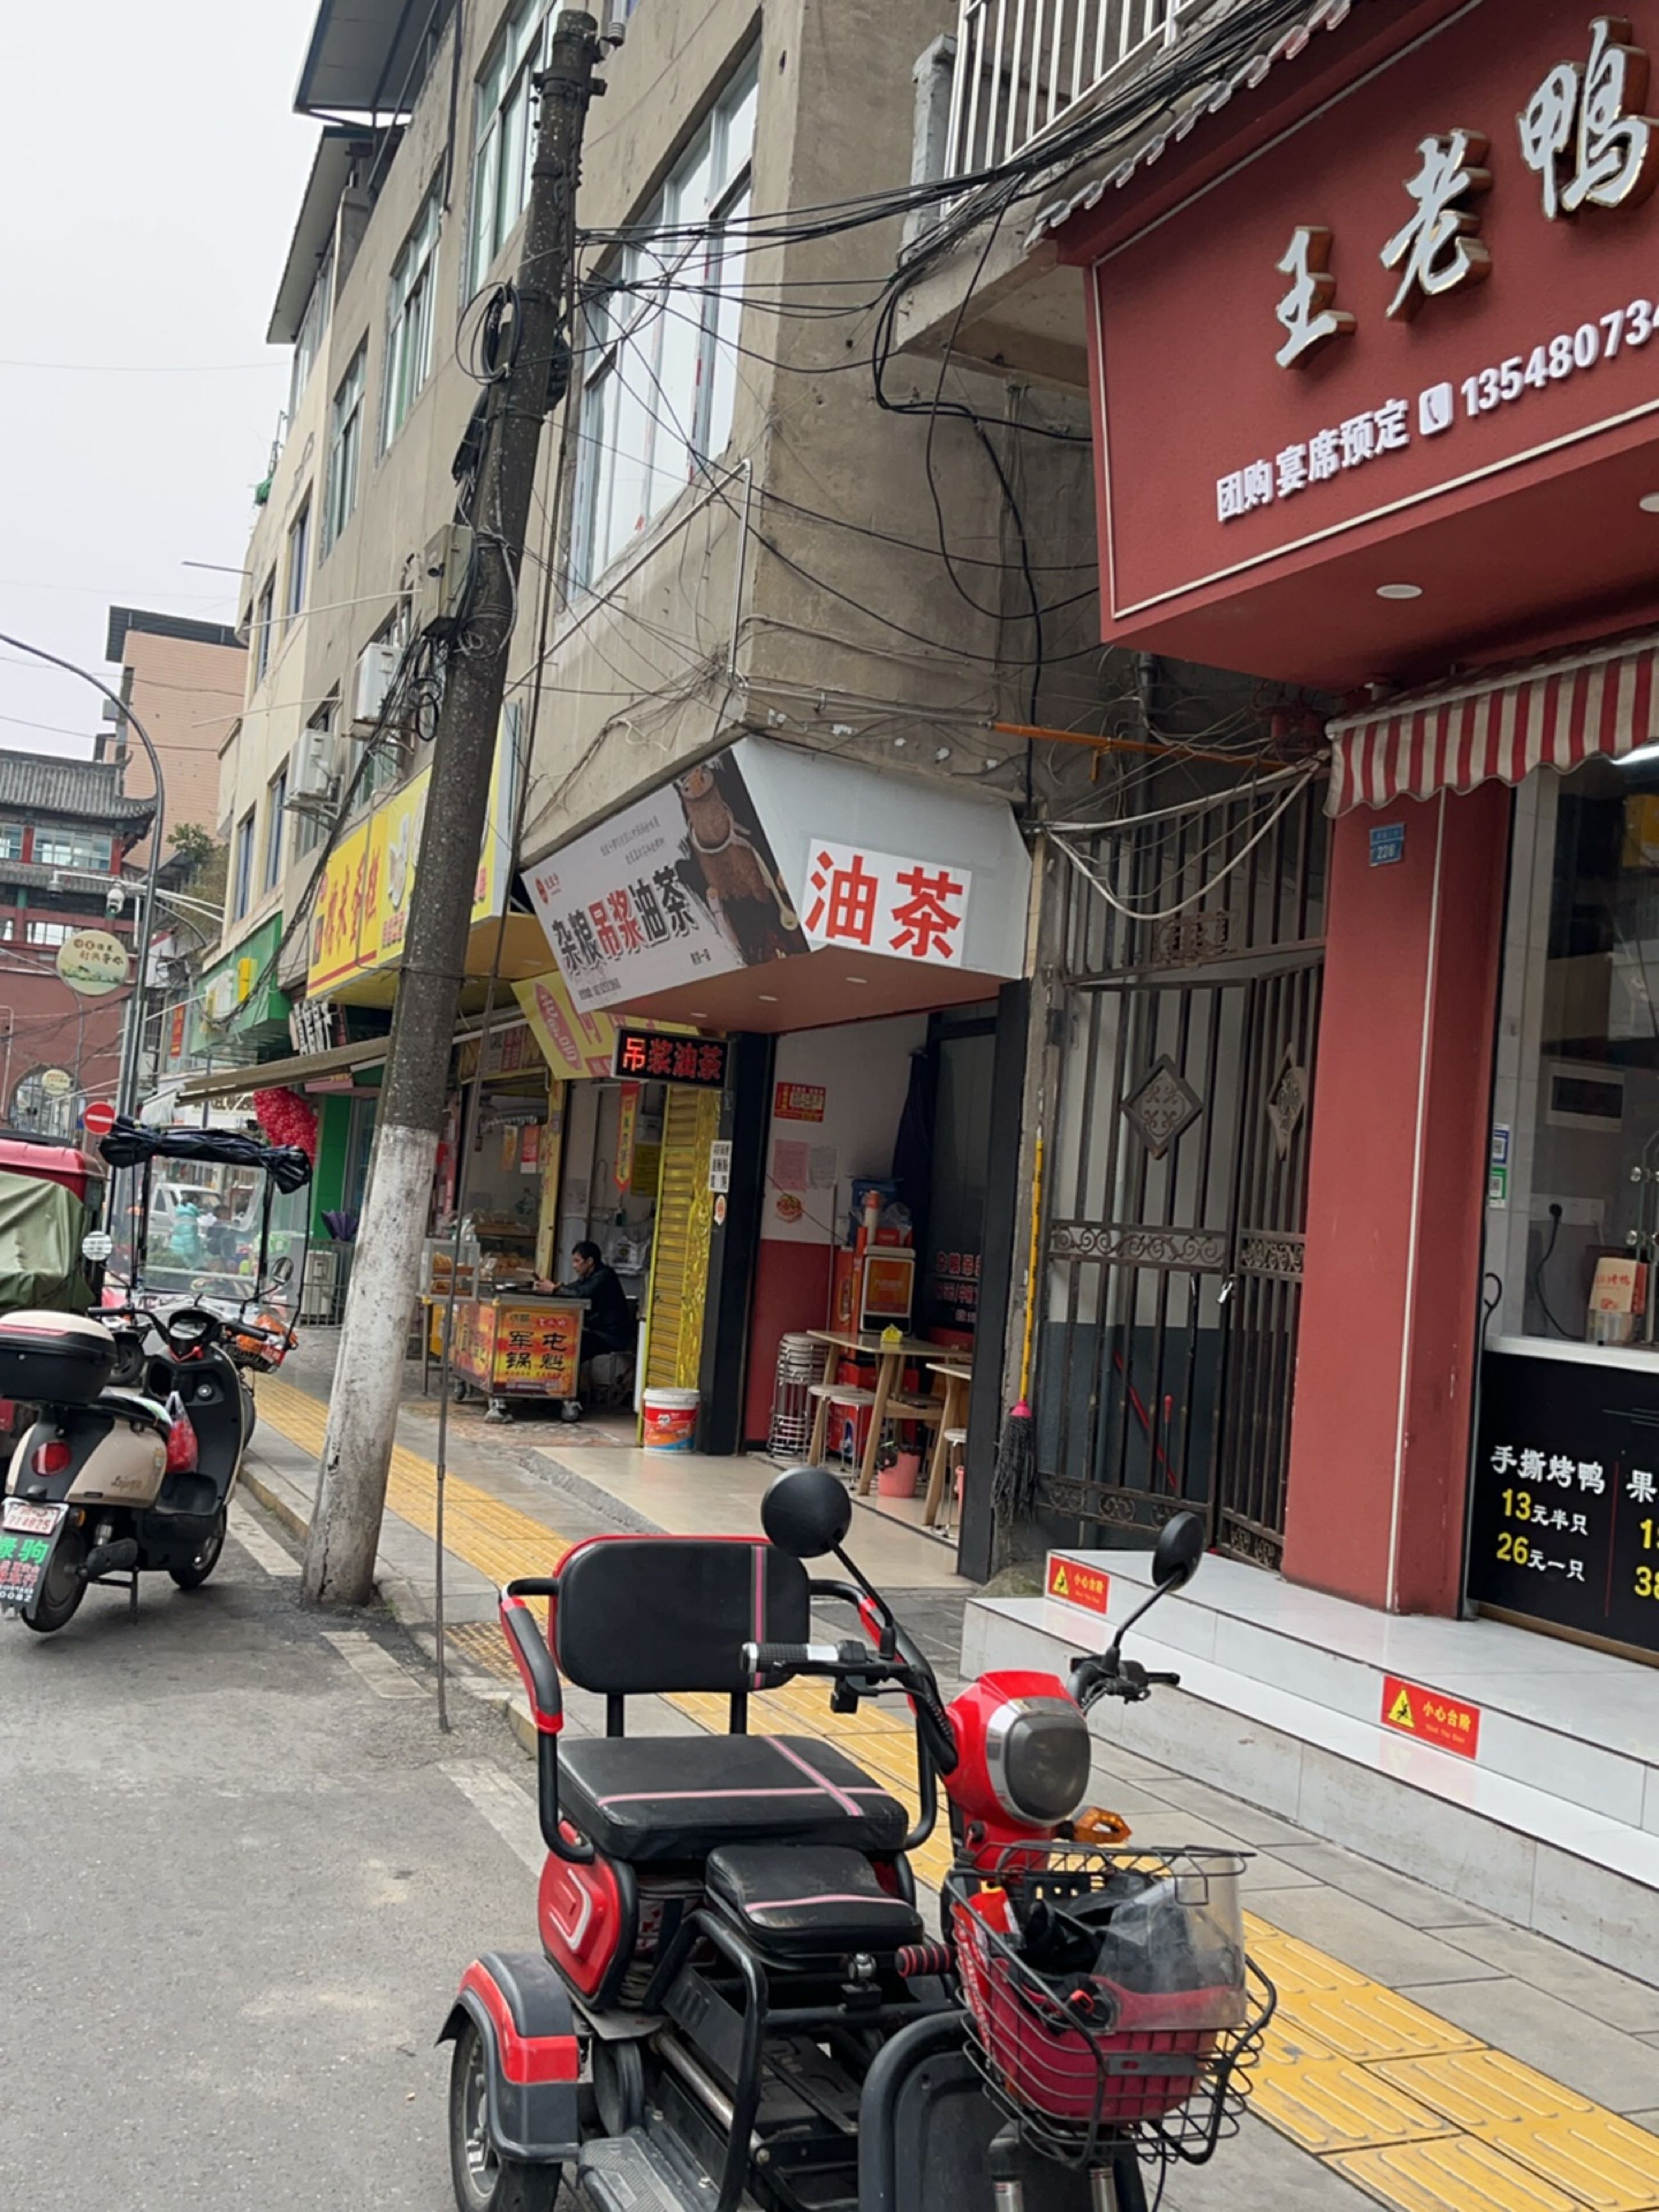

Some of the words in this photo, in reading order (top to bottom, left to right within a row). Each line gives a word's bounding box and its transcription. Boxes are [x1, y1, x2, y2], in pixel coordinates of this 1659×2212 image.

[1275, 15, 1658, 369] 王老鸭
[1460, 299, 1659, 416] 13548073
[1215, 398, 1411, 522] 团购宴席预定
[551, 865, 700, 973] 杂粮吊浆油茶
[805, 851, 963, 960] 油茶
[621, 1036, 723, 1080] 吊浆油茶
[1490, 1445, 1606, 1495] 手撕烤鸭
[1502, 1488, 1589, 1536] 13元半只
[1640, 1518, 1659, 1549] 1
[1496, 1532, 1585, 1582] 26元一只
[1422, 1700, 1471, 1733] 小心台阶
